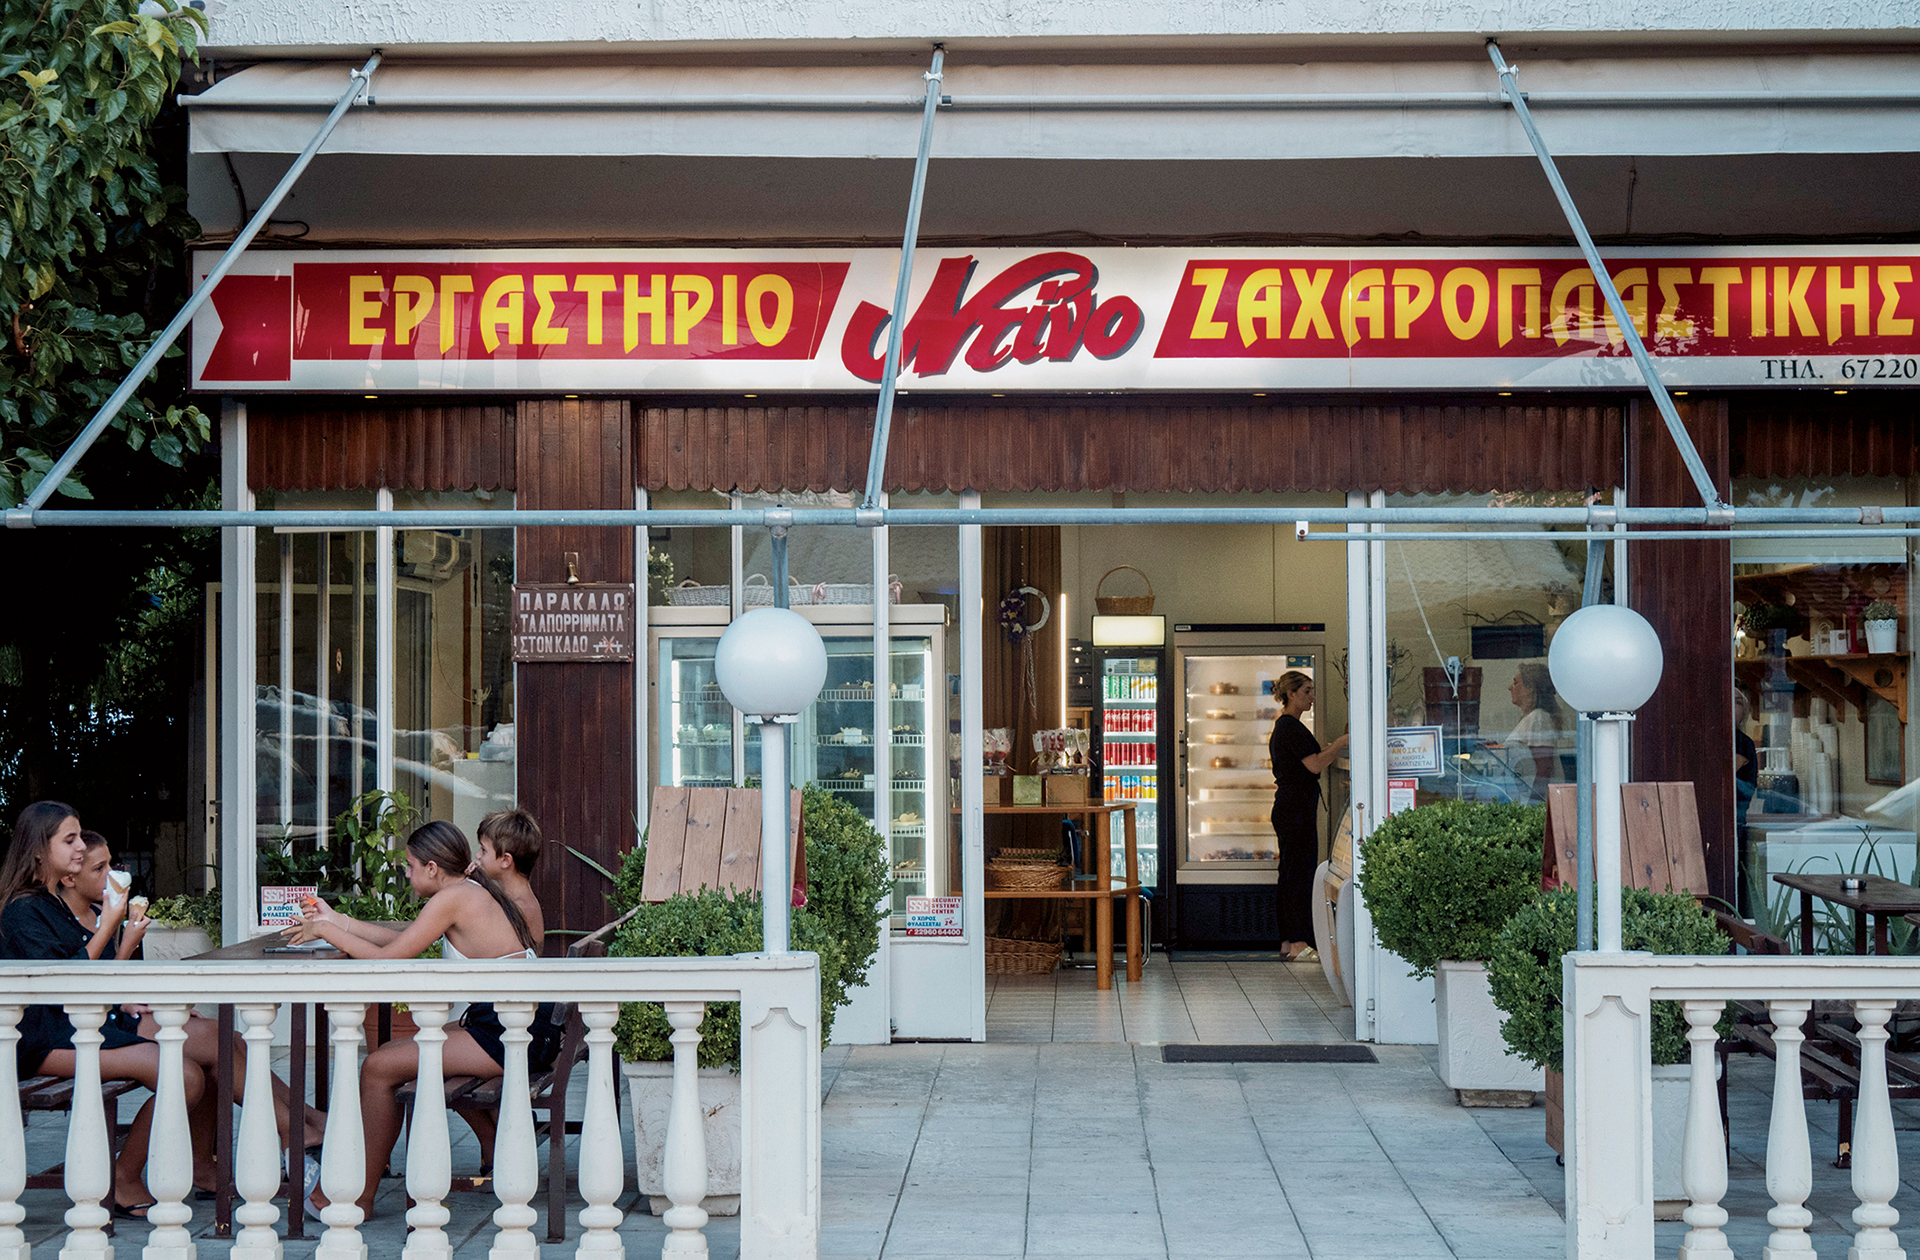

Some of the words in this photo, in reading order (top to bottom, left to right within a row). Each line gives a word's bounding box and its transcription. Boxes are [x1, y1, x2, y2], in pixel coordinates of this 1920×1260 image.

[349, 273, 794, 355] ΕΡΓΑΣΤΗΡΙΟ
[1190, 265, 1913, 349] ΖΑΧΑΡΟΠΛΑΣΤΙΚΗΣ
[1760, 359, 1823, 379] ΤΗΛ.
[1841, 358, 1918, 379] 67220
[519, 592, 625, 611] ΠΑΡΑΚΑΛΩ
[263, 888, 285, 902] SSC
[909, 899, 929, 912] SSC
